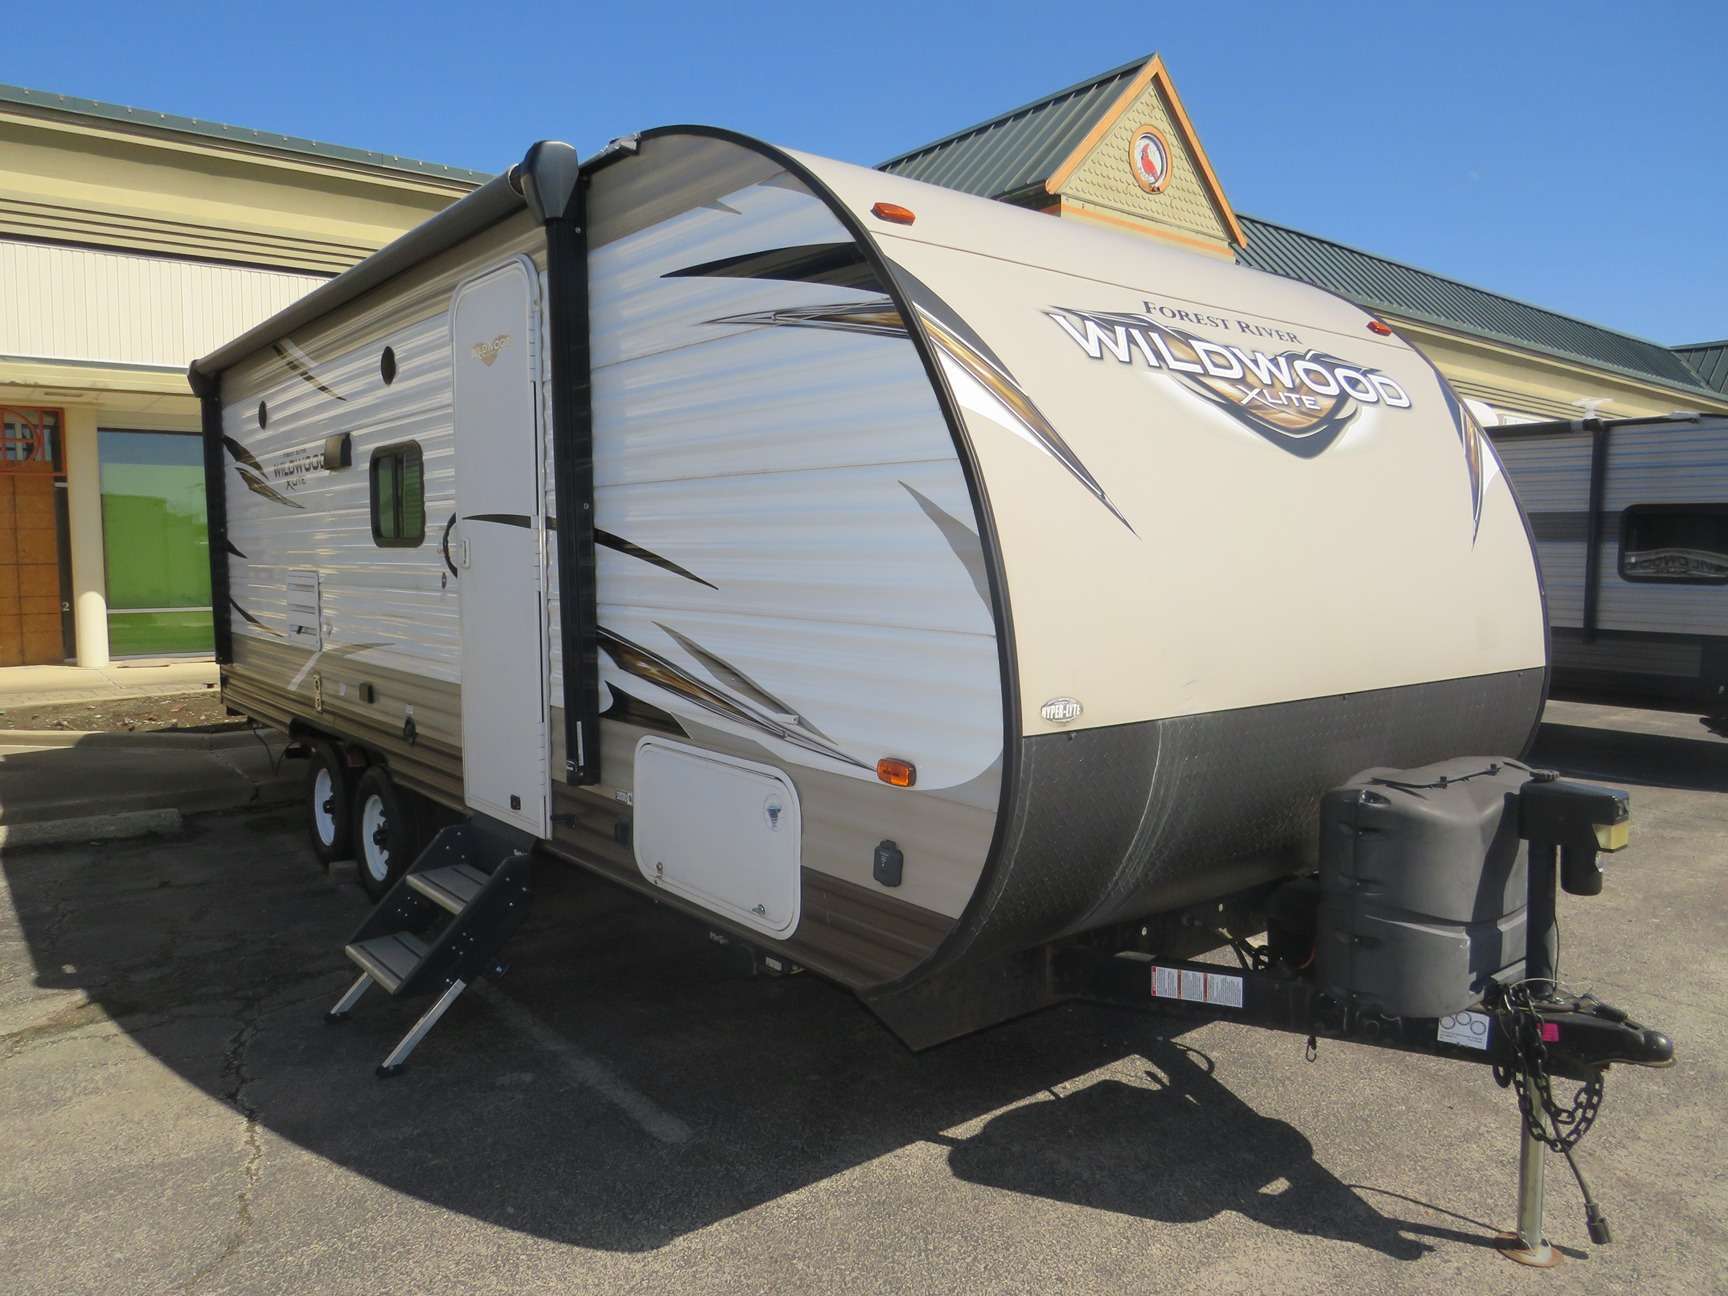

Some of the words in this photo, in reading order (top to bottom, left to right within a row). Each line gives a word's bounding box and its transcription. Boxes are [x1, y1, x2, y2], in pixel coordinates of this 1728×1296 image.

[1142, 301, 1231, 330] FOREST
[1238, 319, 1303, 344] RIVER
[1047, 311, 1412, 409] WILDWOOD
[1236, 384, 1321, 411] XLITE
